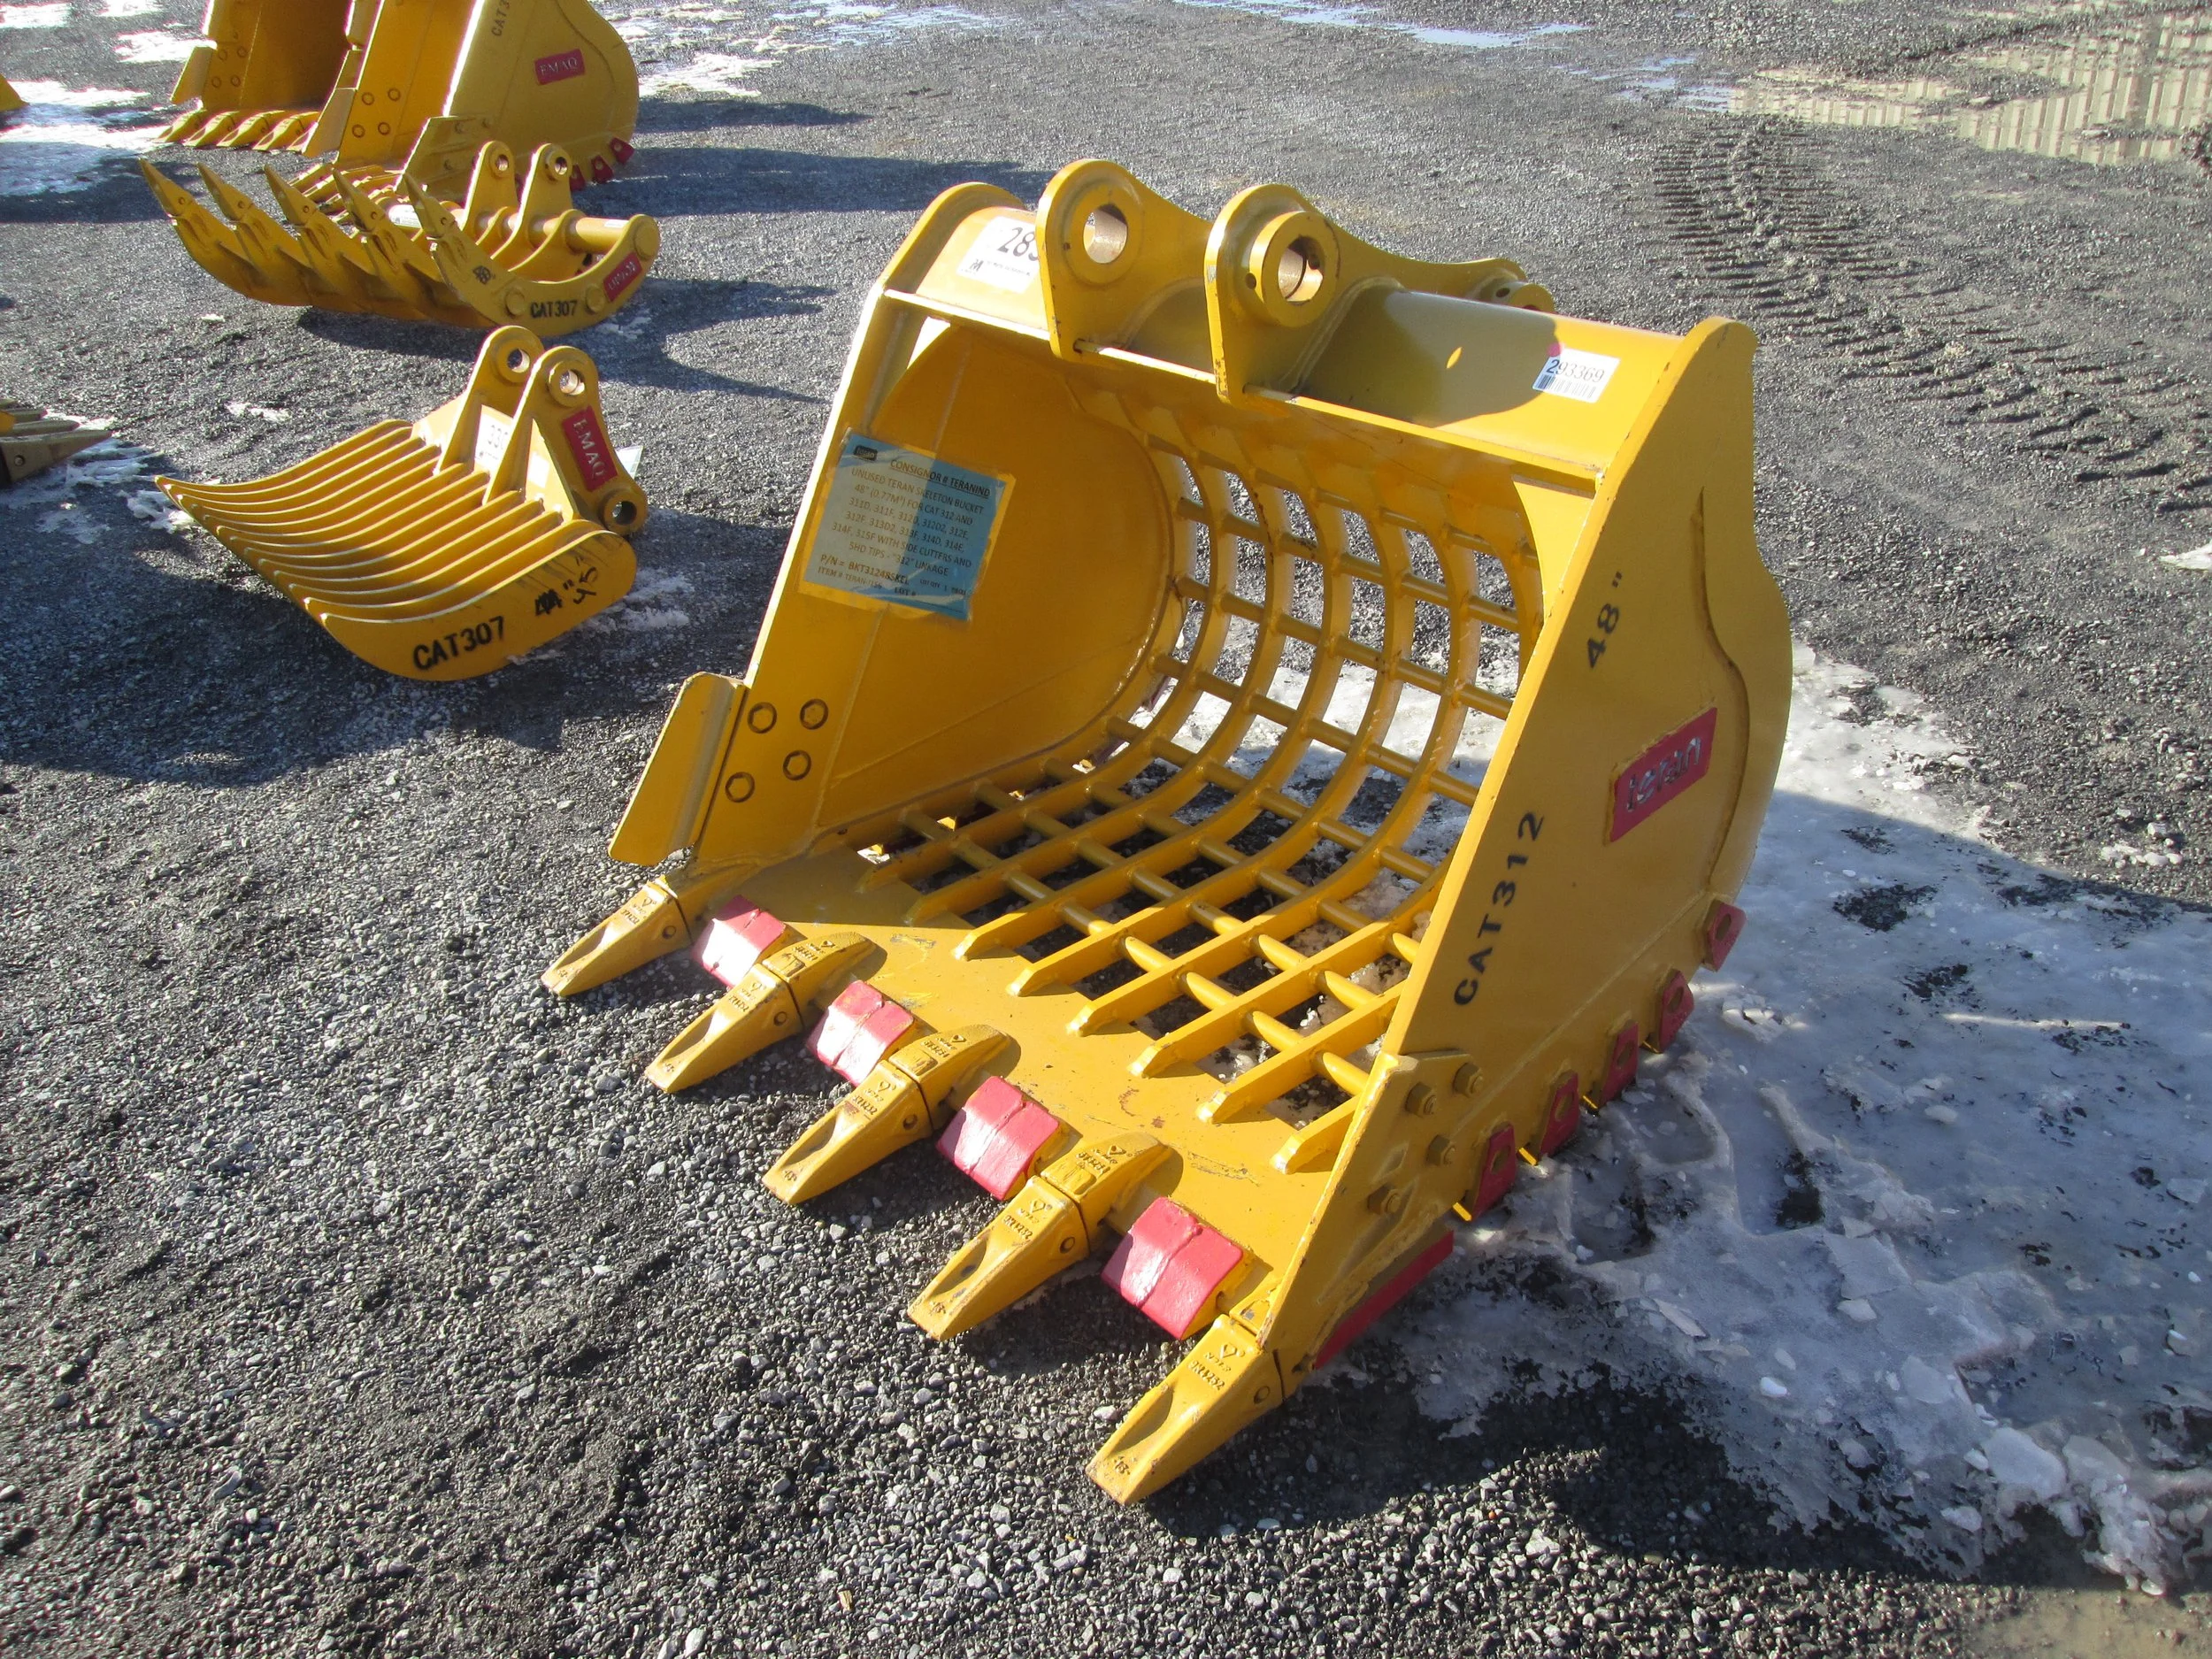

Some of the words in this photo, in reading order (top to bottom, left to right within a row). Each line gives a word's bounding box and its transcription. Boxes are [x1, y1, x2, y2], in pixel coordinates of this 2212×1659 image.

[531, 301, 578, 319] CAT307
[1546, 358, 1604, 383] 293369
[572, 418, 608, 480] EMAQ
[850, 467, 886, 484] UNUSED
[887, 478, 915, 493] TERAN
[914, 487, 953, 504] SKELETON
[954, 499, 984, 514] BUCKET
[889, 458, 941, 480] CONSIGNOR
[949, 478, 991, 497] TERANIND
[906, 499, 923, 511] FOR
[923, 504, 940, 516] CAT
[940, 510, 954, 520] 312
[955, 514, 973, 526] AND
[819, 553, 838, 565] P/N
[867, 547, 885, 558] TIPS
[914, 559, 949, 576] LINKAGE
[876, 534, 899, 547] WITH
[900, 541, 918, 552] SIDE
[918, 546, 953, 563] CUTTERS
[953, 557, 972, 568] AND
[817, 565, 837, 578] ITEM
[412, 615, 505, 670] CAT307
[1453, 811, 1545, 1006] CAT312
